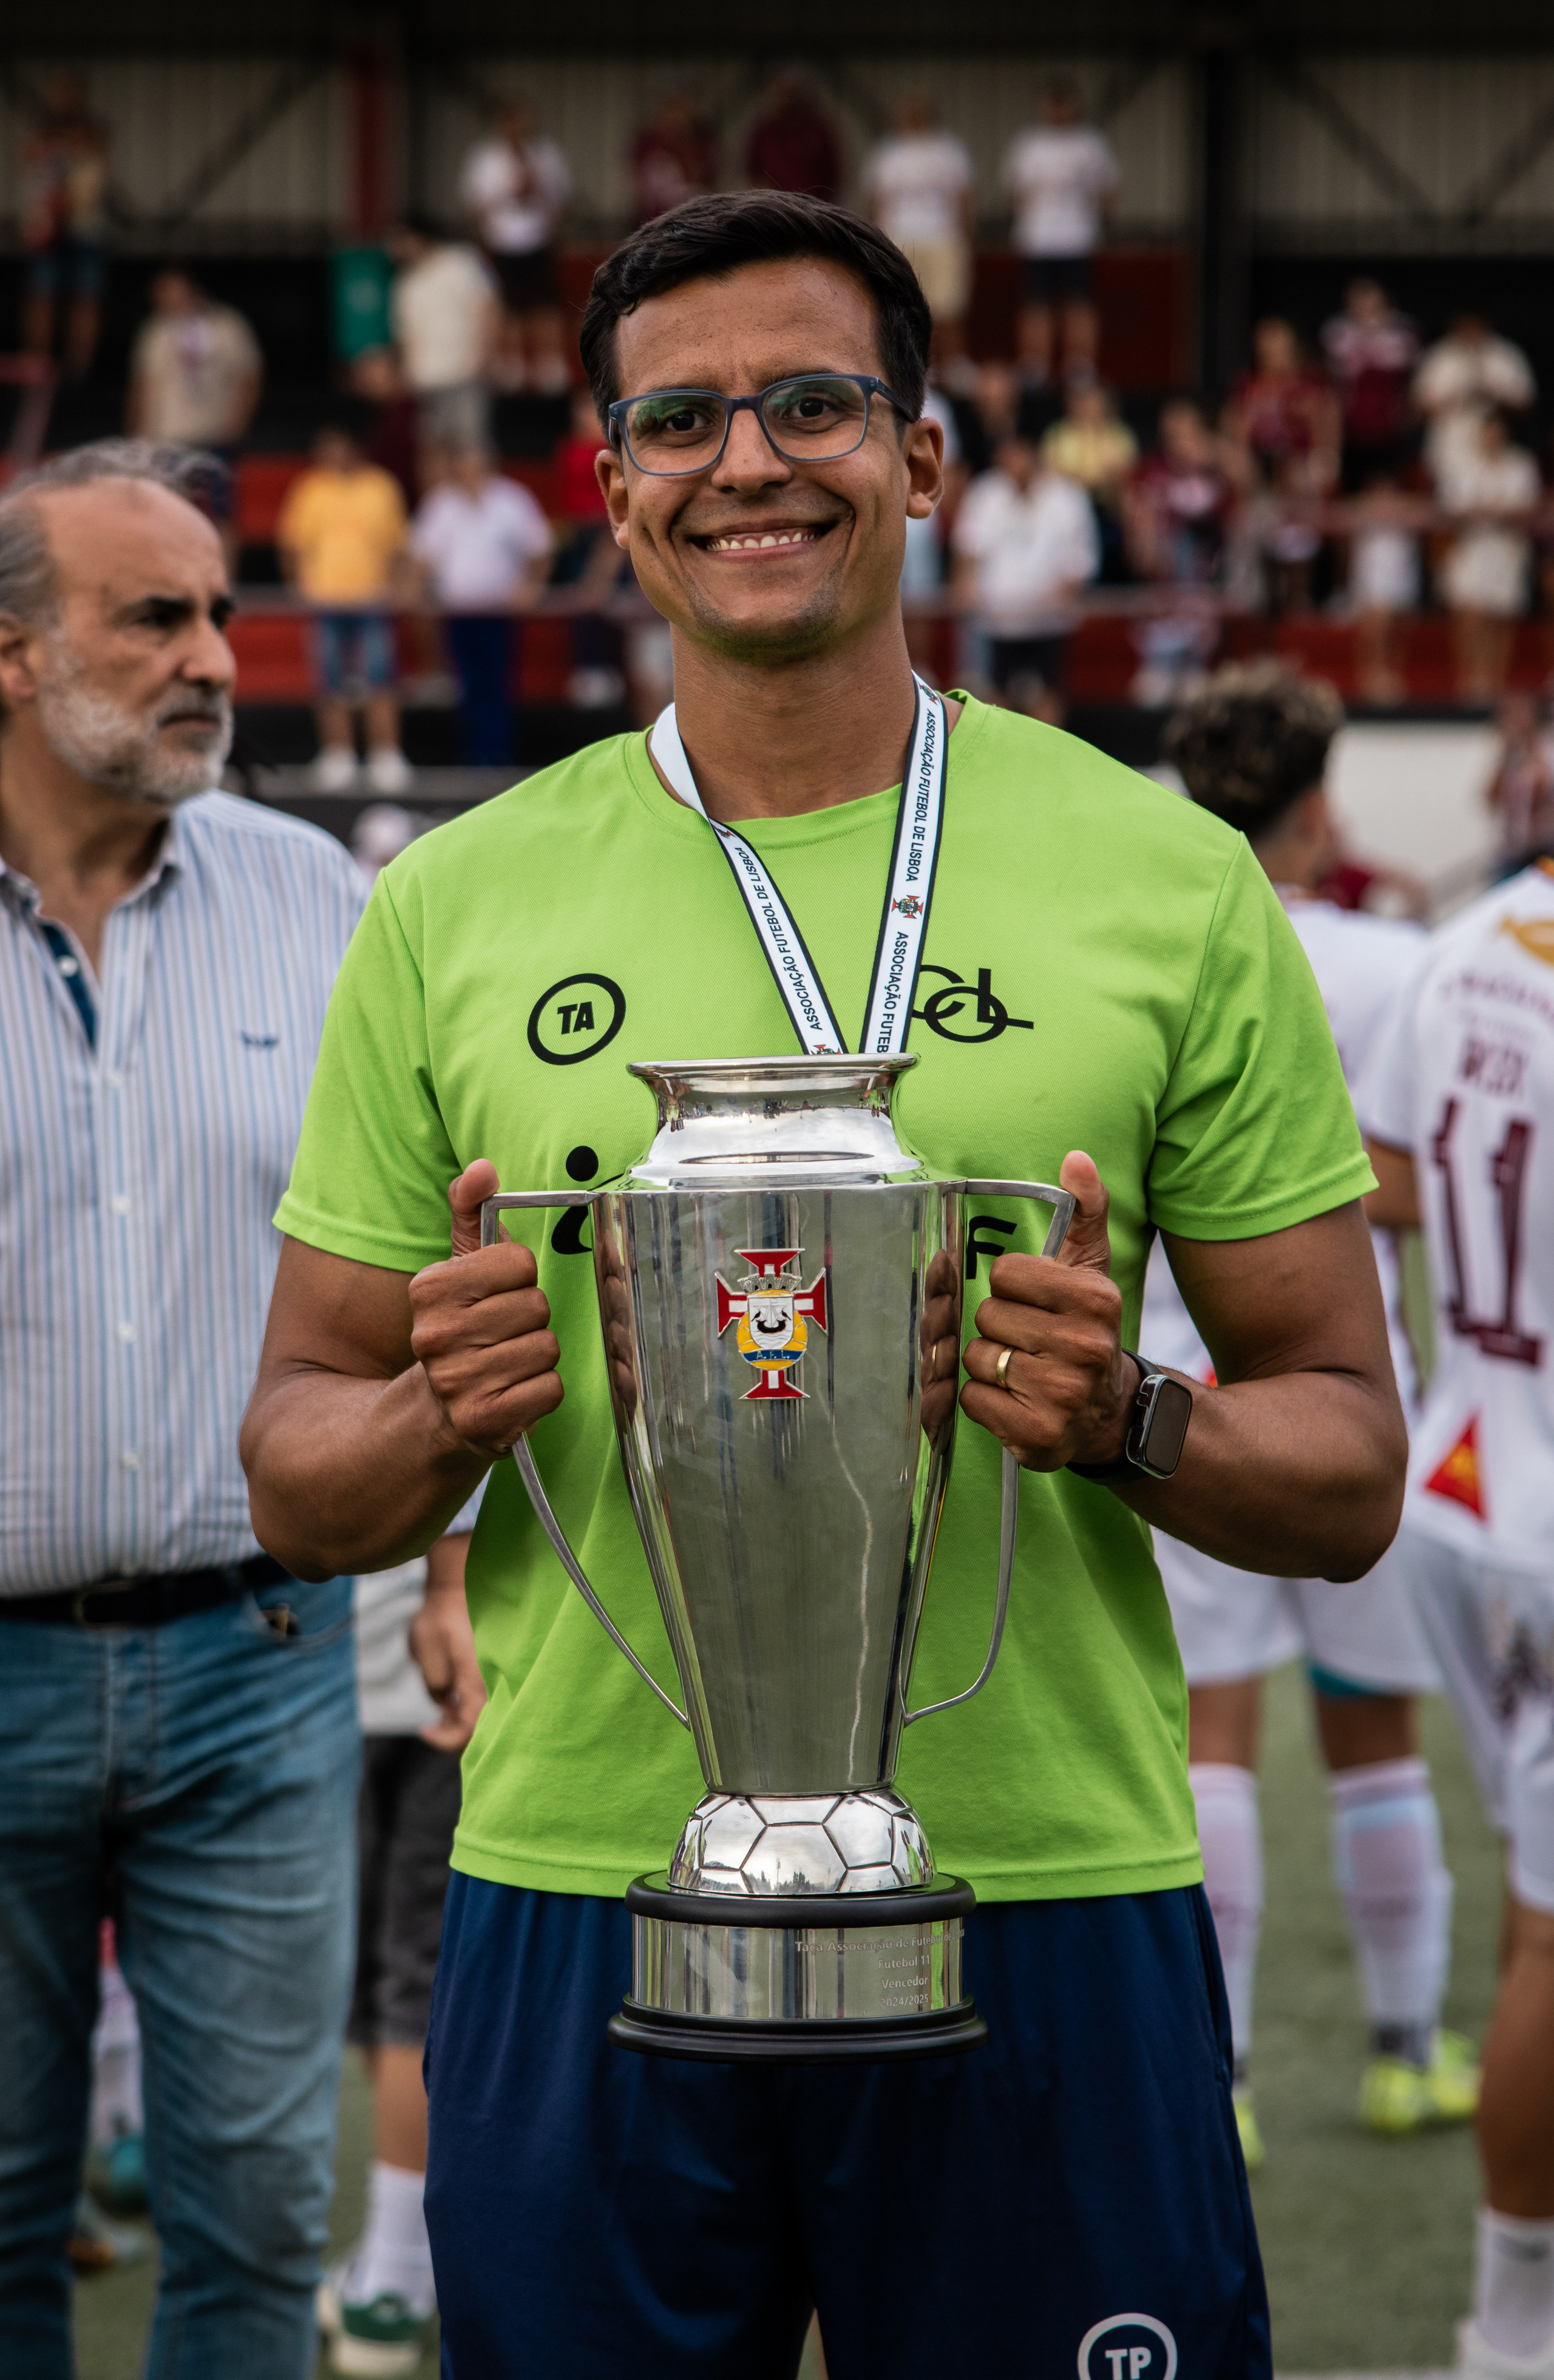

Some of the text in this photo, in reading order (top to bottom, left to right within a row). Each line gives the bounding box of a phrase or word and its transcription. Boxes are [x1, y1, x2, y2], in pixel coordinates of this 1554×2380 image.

[906, 709, 936, 882] ASSOCIAÇÃO FUTEBOL DE LISBOA
[735, 847, 823, 1030] ASSOCIAÇÃO FUTEBOL DE LISBOA
[884, 931, 909, 1010] ASSOCIAÇÃO
[557, 1001, 595, 1035] TA
[1431, 1096, 1543, 1370] 11
[795, 1941, 823, 1954] Taça
[827, 1939, 892, 1953] Associação
[896, 1937, 909, 1948] de
[945, 1931, 952, 1941] de
[878, 1954, 929, 1969] Futebol 11
[882, 1975, 929, 1988] Vencedor
[880, 1994, 929, 2007] 2024/2025
[1105, 2347, 1152, 2380] TP
